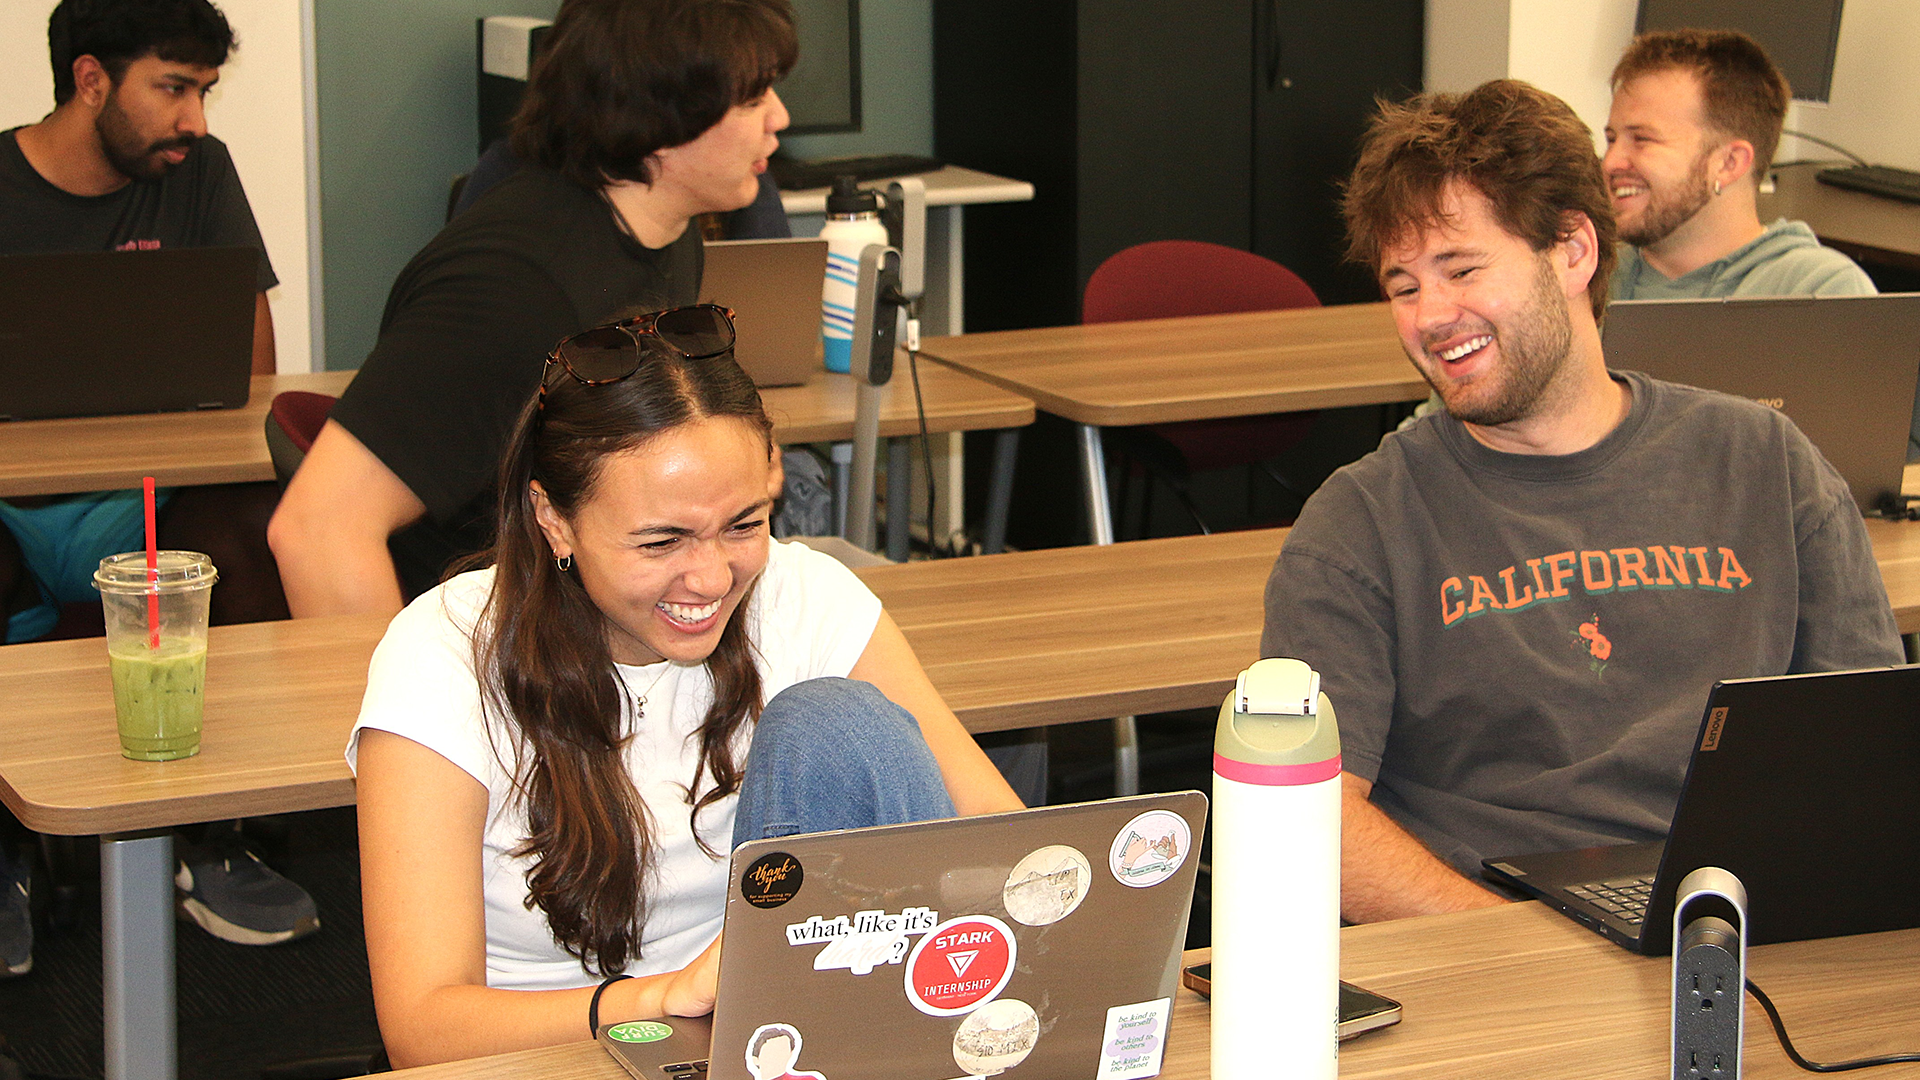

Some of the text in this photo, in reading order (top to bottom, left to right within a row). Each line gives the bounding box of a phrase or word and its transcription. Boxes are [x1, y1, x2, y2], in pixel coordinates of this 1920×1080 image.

[1440, 545, 1752, 628] CALIFORNIA
[1705, 711, 1724, 747] Lenovo
[749, 858, 797, 886] thank
[763, 873, 787, 894] you
[793, 912, 933, 938] what, like it's
[935, 931, 994, 949] STARK
[924, 979, 991, 996] INTERNSHIP
[1130, 1012, 1148, 1021] kind
[614, 1025, 658, 1034] DIVA
[1120, 1018, 1153, 1030] yourself
[621, 1029, 667, 1040] SURF
[1127, 1035, 1145, 1043] kind
[1121, 1042, 1145, 1050] others
[1123, 1056, 1141, 1064] kind
[1124, 1062, 1148, 1071] planet
